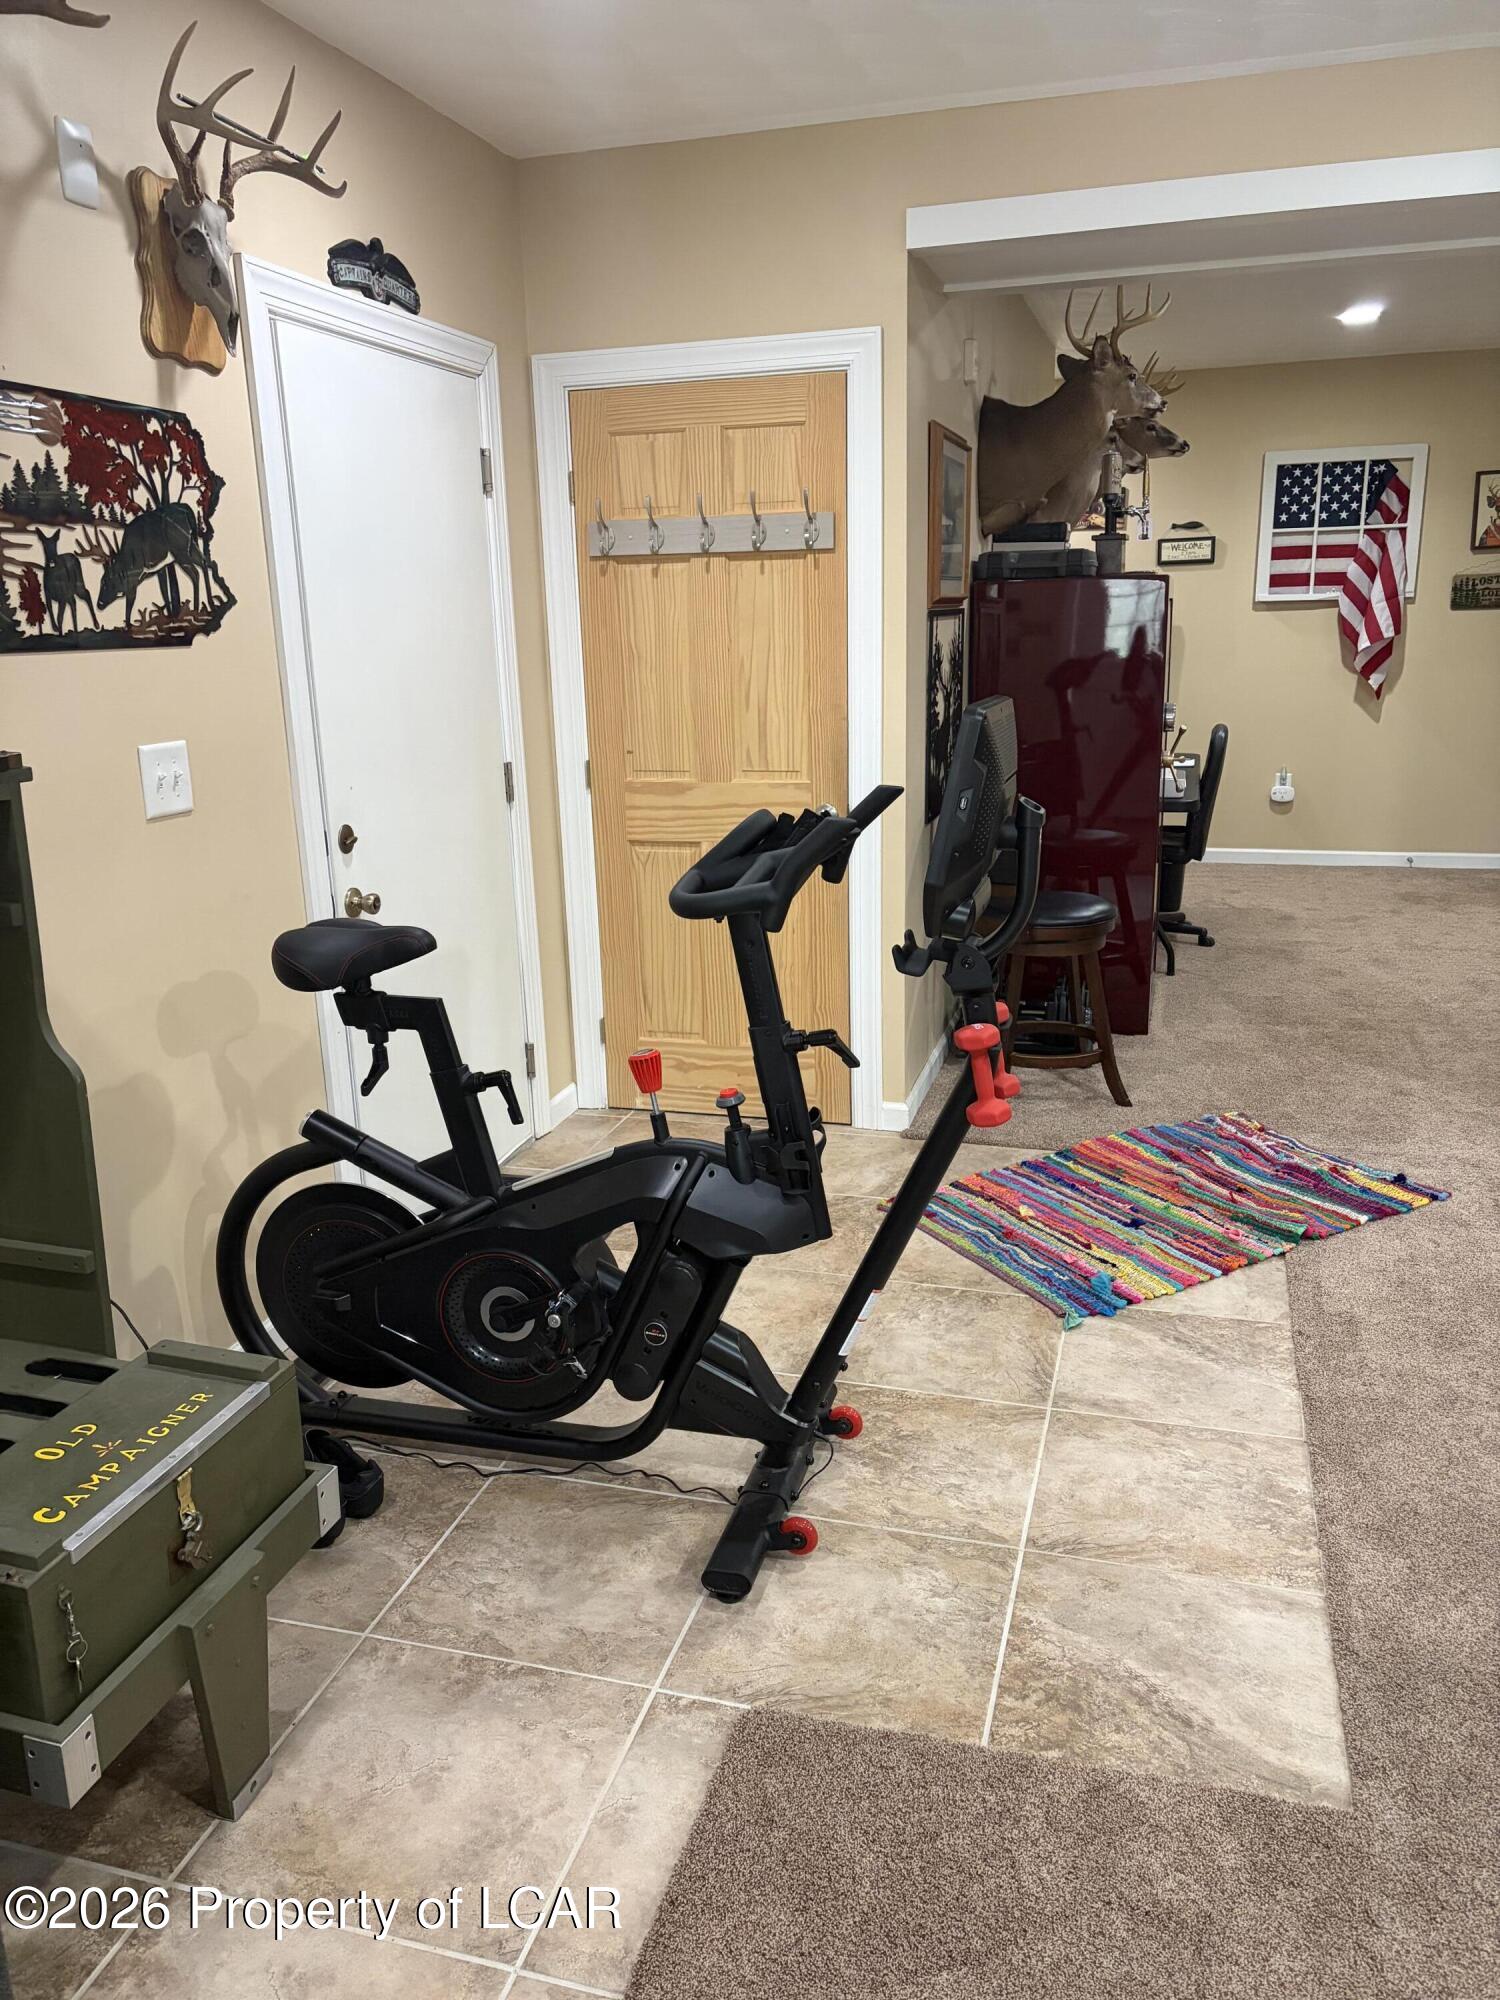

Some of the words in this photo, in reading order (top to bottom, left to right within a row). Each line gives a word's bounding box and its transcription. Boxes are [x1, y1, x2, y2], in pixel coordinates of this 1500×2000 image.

[1171, 542, 1205, 551] WELCOME
[1472, 576, 1500, 588] LOST
[34, 1423, 98, 1460] OLD
[33, 1393, 213, 1523] CAMPAIGNER
